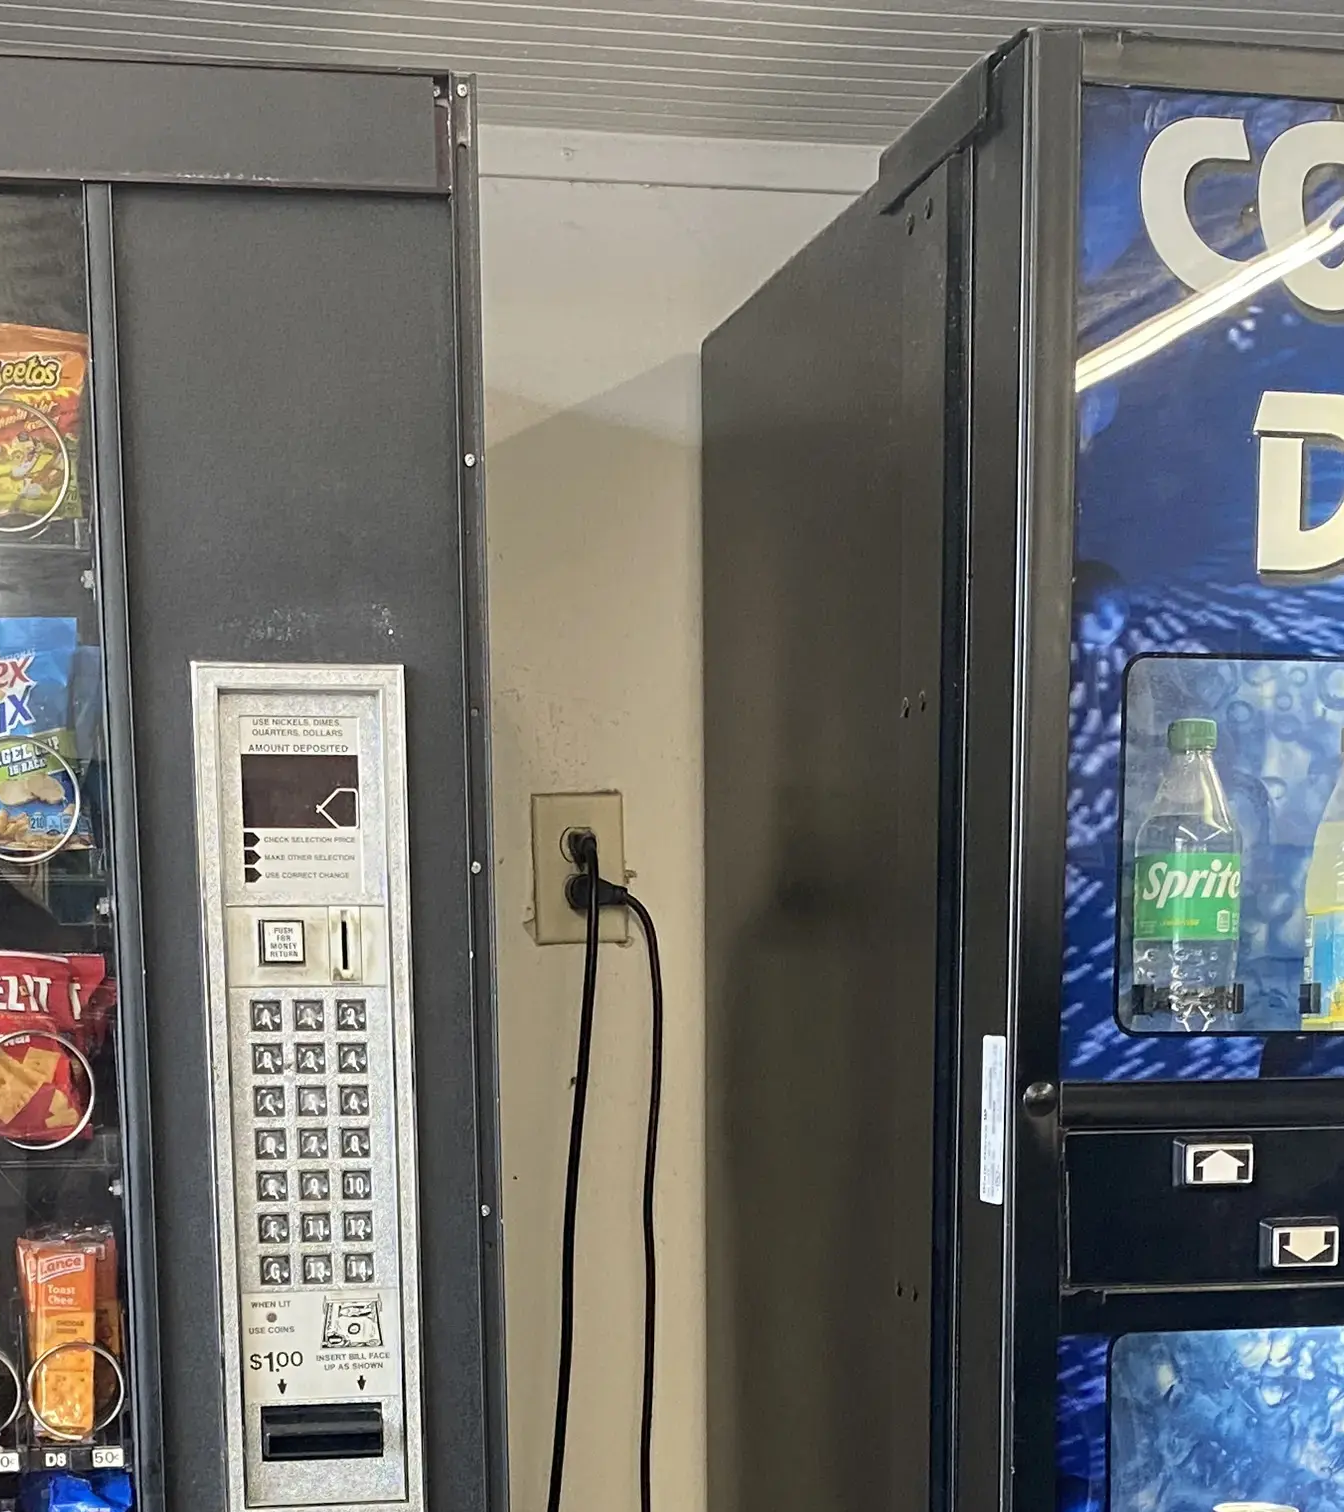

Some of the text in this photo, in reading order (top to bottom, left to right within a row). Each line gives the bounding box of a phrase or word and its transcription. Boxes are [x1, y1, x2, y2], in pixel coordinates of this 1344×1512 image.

[303, 729, 343, 737] DOLLARS
[248, 744, 348, 752] AMOUNT DEPOSITED
[1143, 859, 1240, 908] Sprite
[348, 1178, 364, 1192] 10
[40, 1256, 82, 1275] Lance
[48, 1285, 75, 1294] Toast
[268, 1326, 294, 1334] COINS
[250, 1351, 303, 1372] $1.00
[353, 1362, 383, 1370] SHOWN
[45, 1453, 67, 1467] D8
